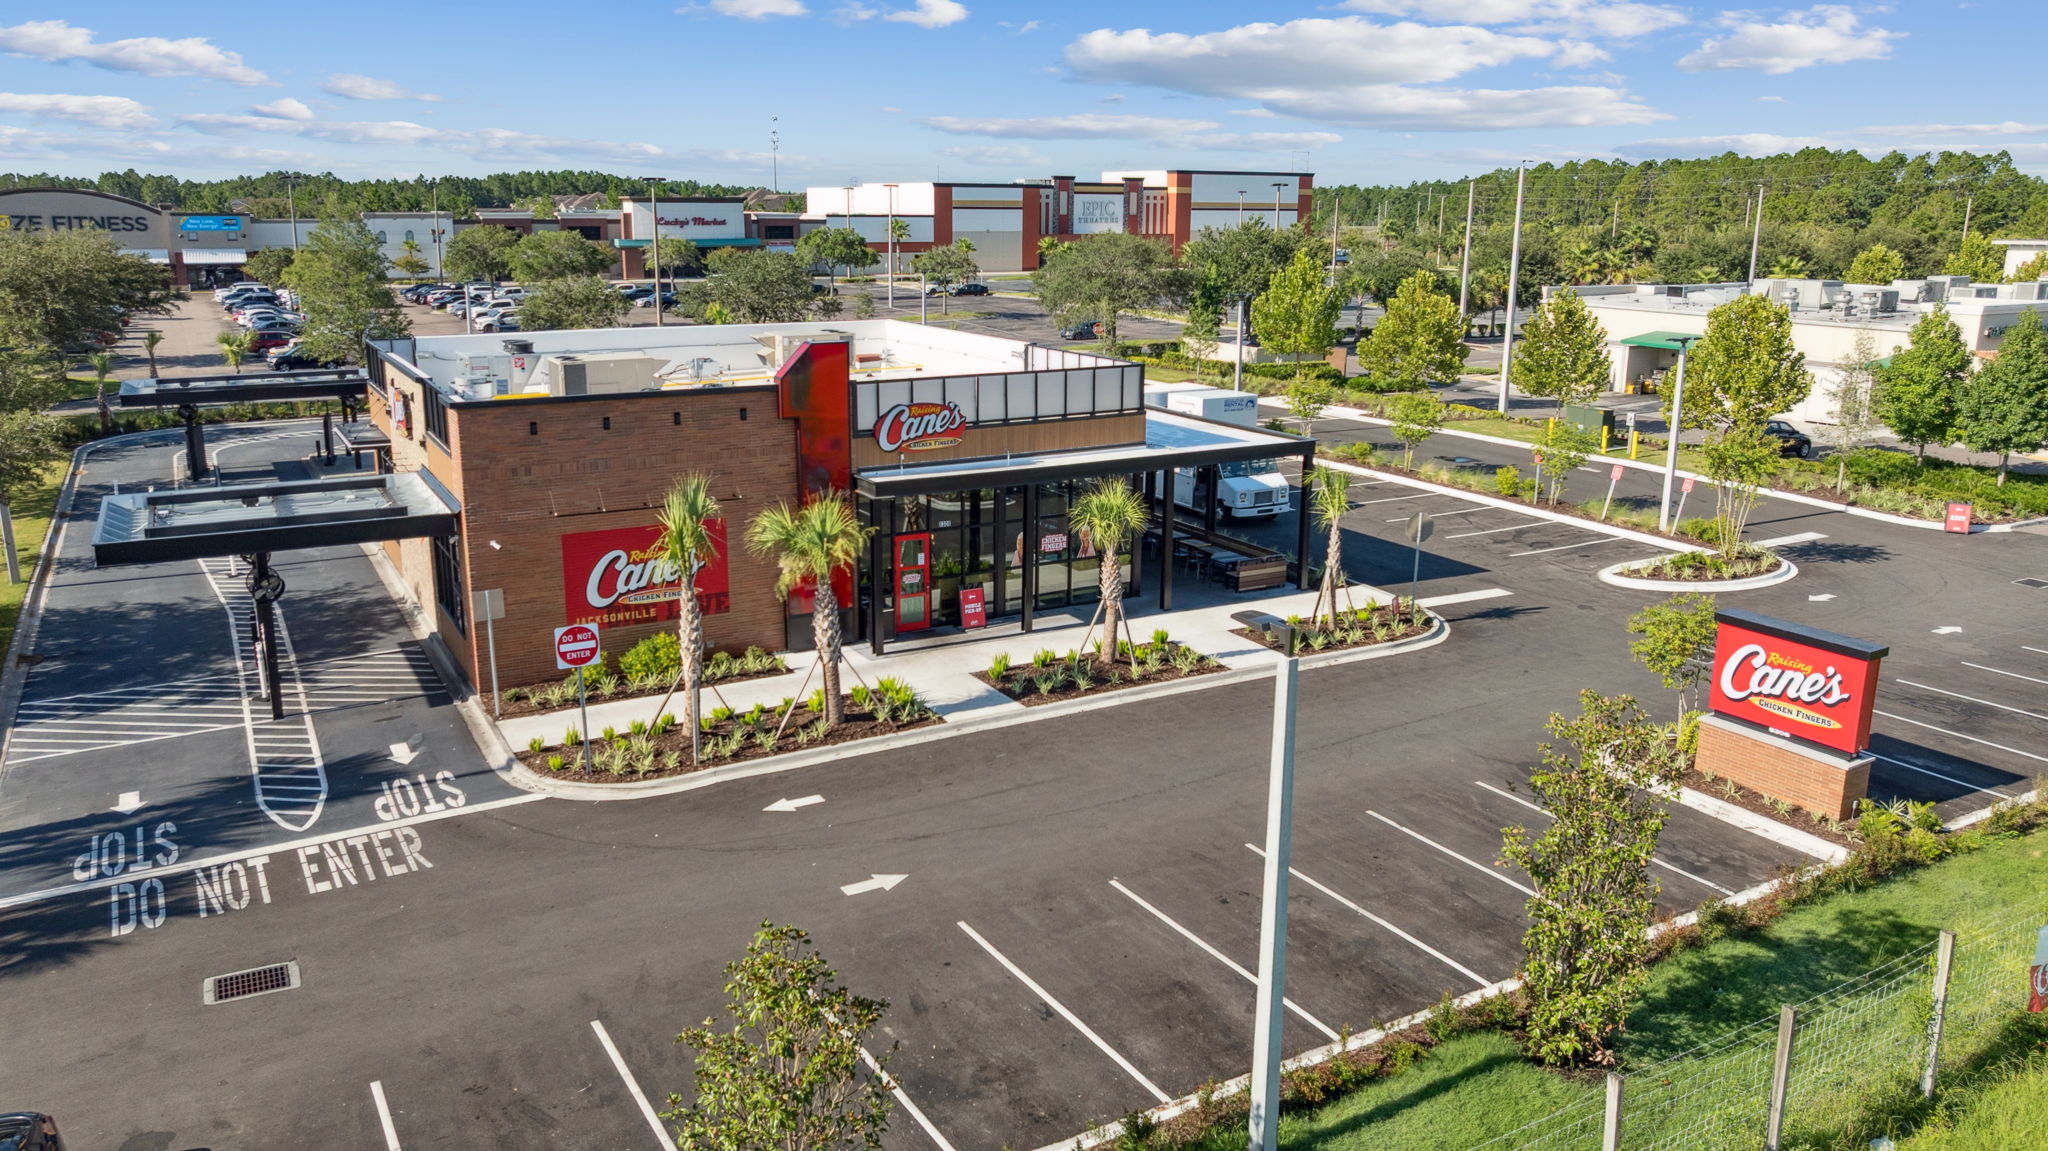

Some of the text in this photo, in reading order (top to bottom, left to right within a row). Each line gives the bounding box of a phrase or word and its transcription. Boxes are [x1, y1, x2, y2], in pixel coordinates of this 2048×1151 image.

[1082, 201, 1116, 216] EPIC
[51, 215, 149, 232] FITNESS
[656, 217, 727, 228] Lucky's Market
[910, 405, 941, 417] Raising
[878, 401, 967, 452] Cane's
[627, 591, 661, 603] CHICKEN
[562, 632, 592, 643] DO NOT
[566, 650, 591, 660] ENTER
[1766, 651, 1813, 675] Raising
[1720, 643, 1850, 706] Cane's
[1758, 699, 1832, 727] CHICKEN FINGERS
[373, 770, 466, 821] STOP
[73, 821, 180, 882] STOP
[111, 826, 434, 937] DO NOT ENTER
